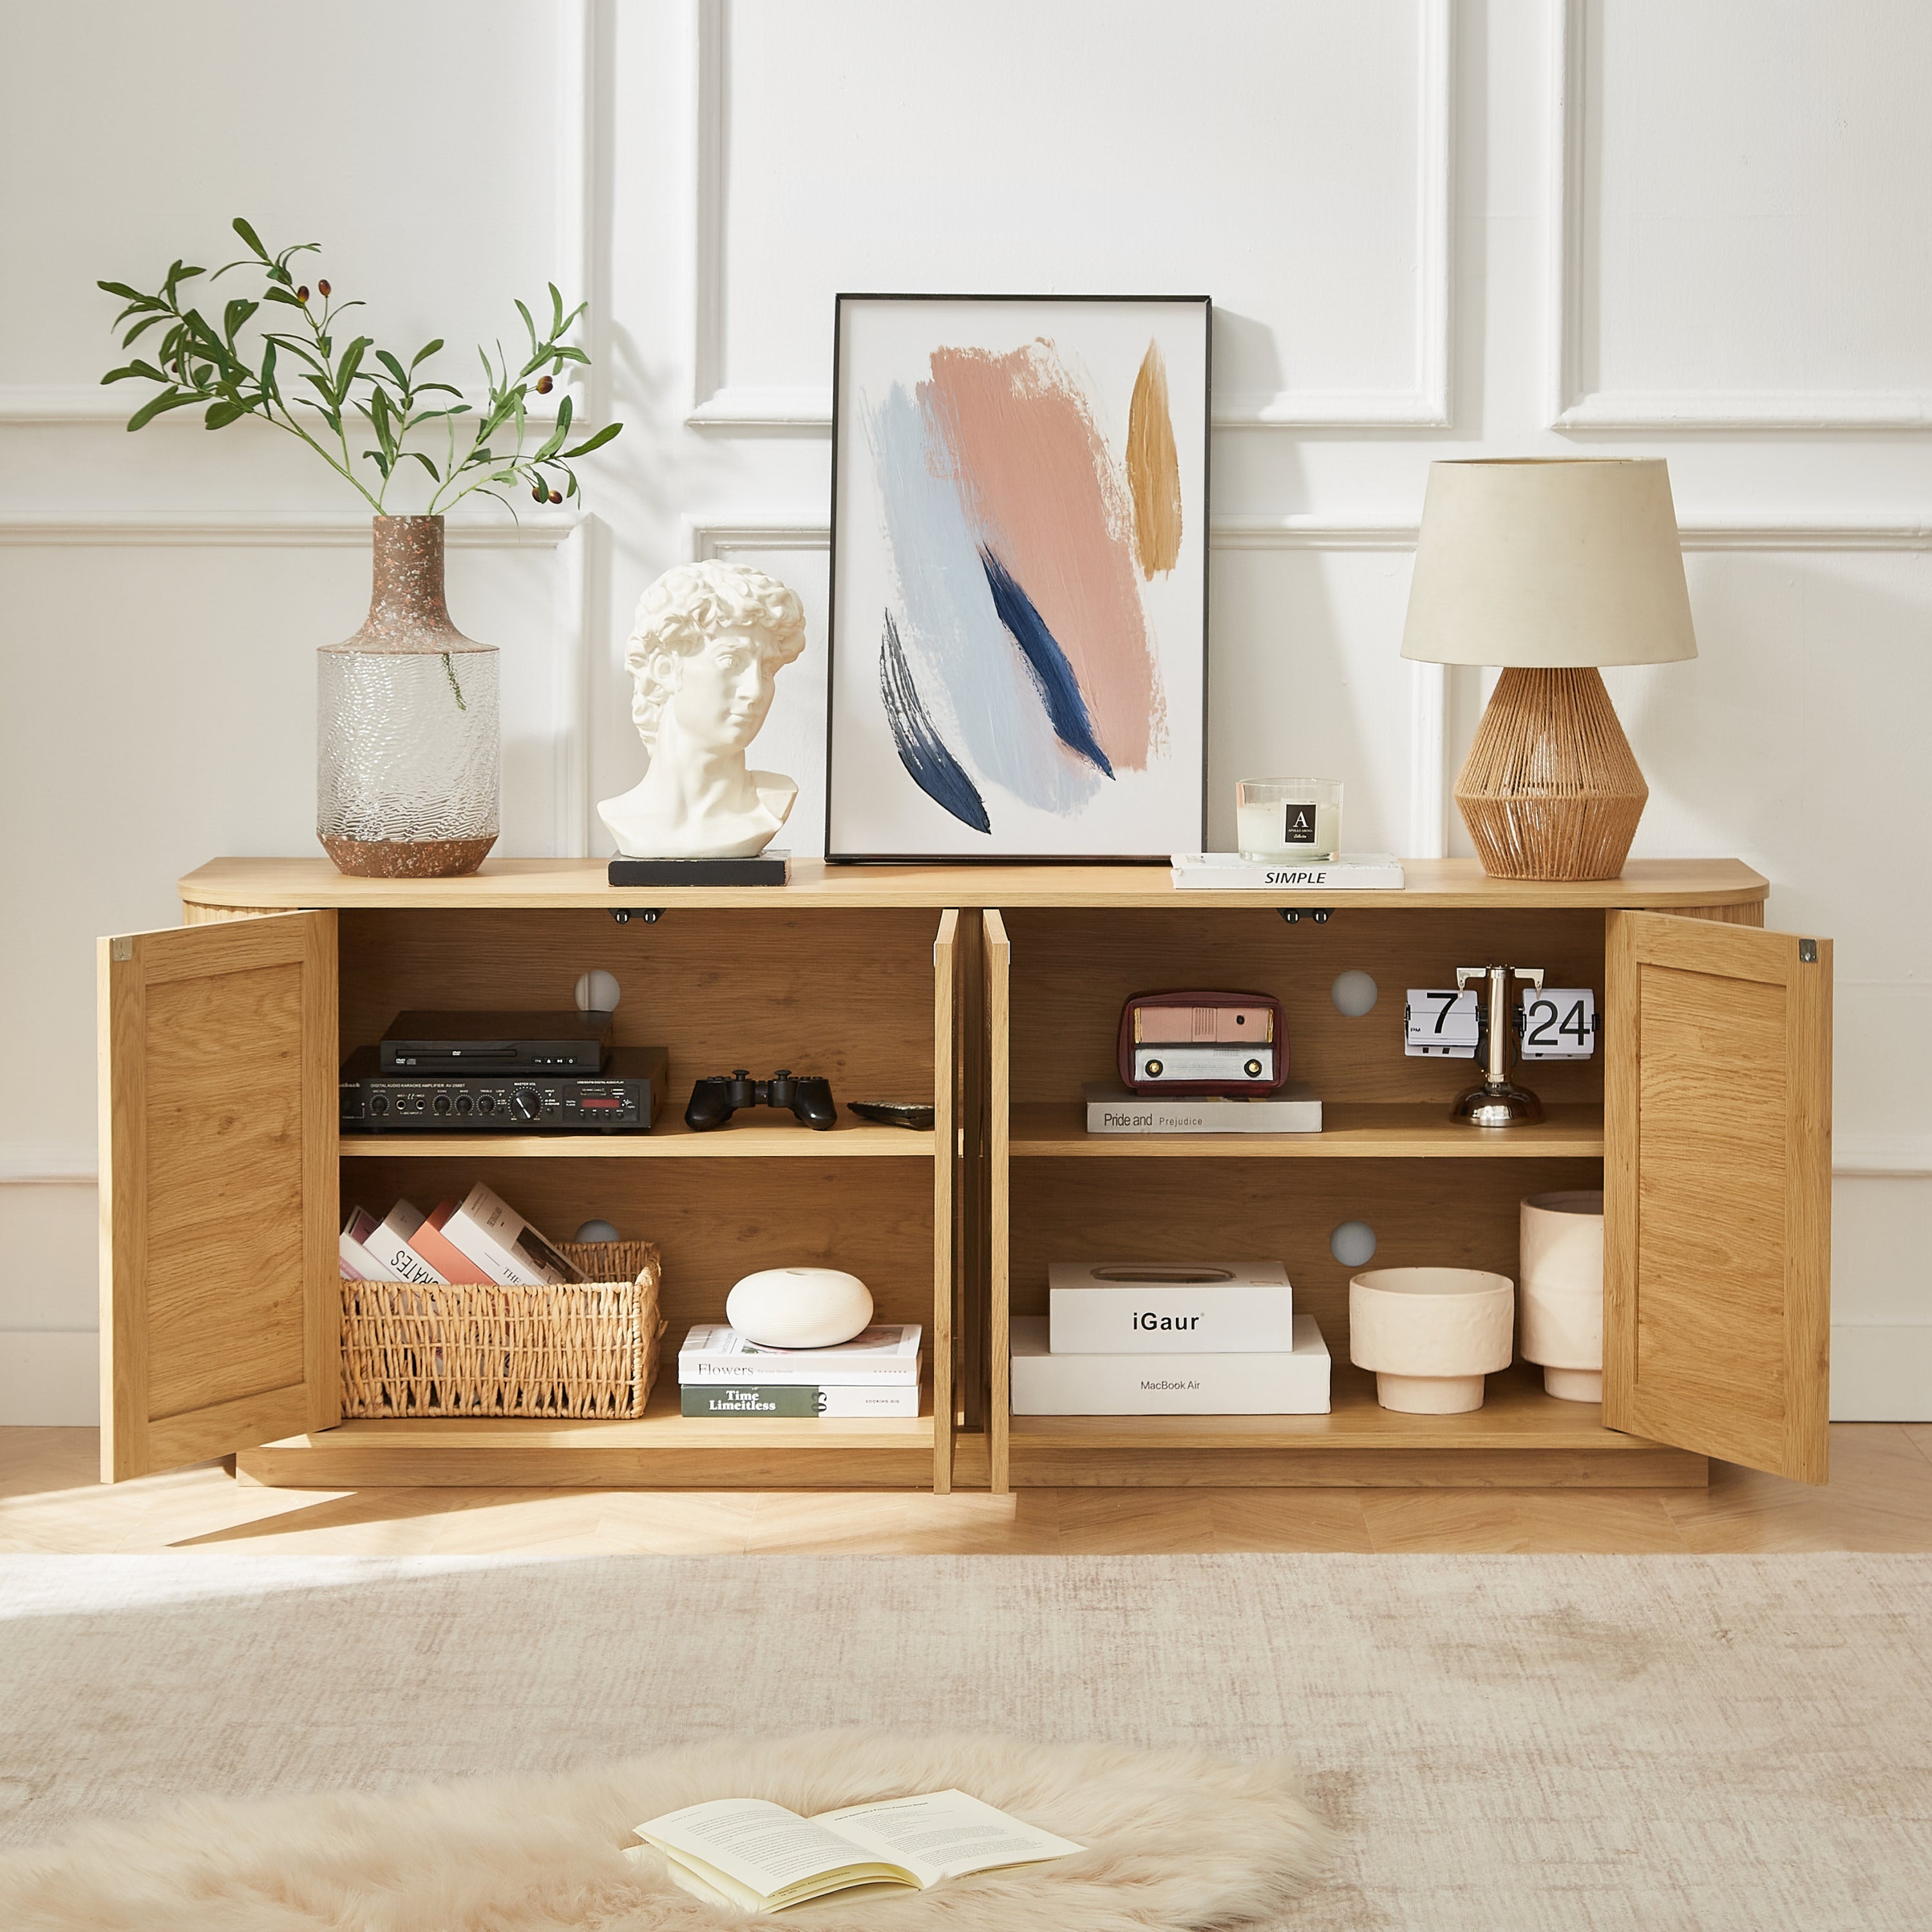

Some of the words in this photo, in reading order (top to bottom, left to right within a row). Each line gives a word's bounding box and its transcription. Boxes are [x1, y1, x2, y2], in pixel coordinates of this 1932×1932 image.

[1293, 811, 1309, 828] A
[1265, 872, 1327, 884] SIMPLE
[1426, 992, 1458, 1034] 7
[1528, 1000, 1590, 1046] 24
[1104, 1113, 1131, 1126] Pride
[1133, 1113, 1153, 1126] and
[1159, 1117, 1203, 1127] Prejudice
[390, 1251, 439, 1284] RATES
[503, 1267, 522, 1285] THE
[698, 1363, 754, 1376] Flowers
[1141, 1381, 1186, 1390] MacBook
[1187, 1381, 1200, 1390] Air
[726, 1390, 760, 1401] Time
[709, 1400, 777, 1411] Limeitless
